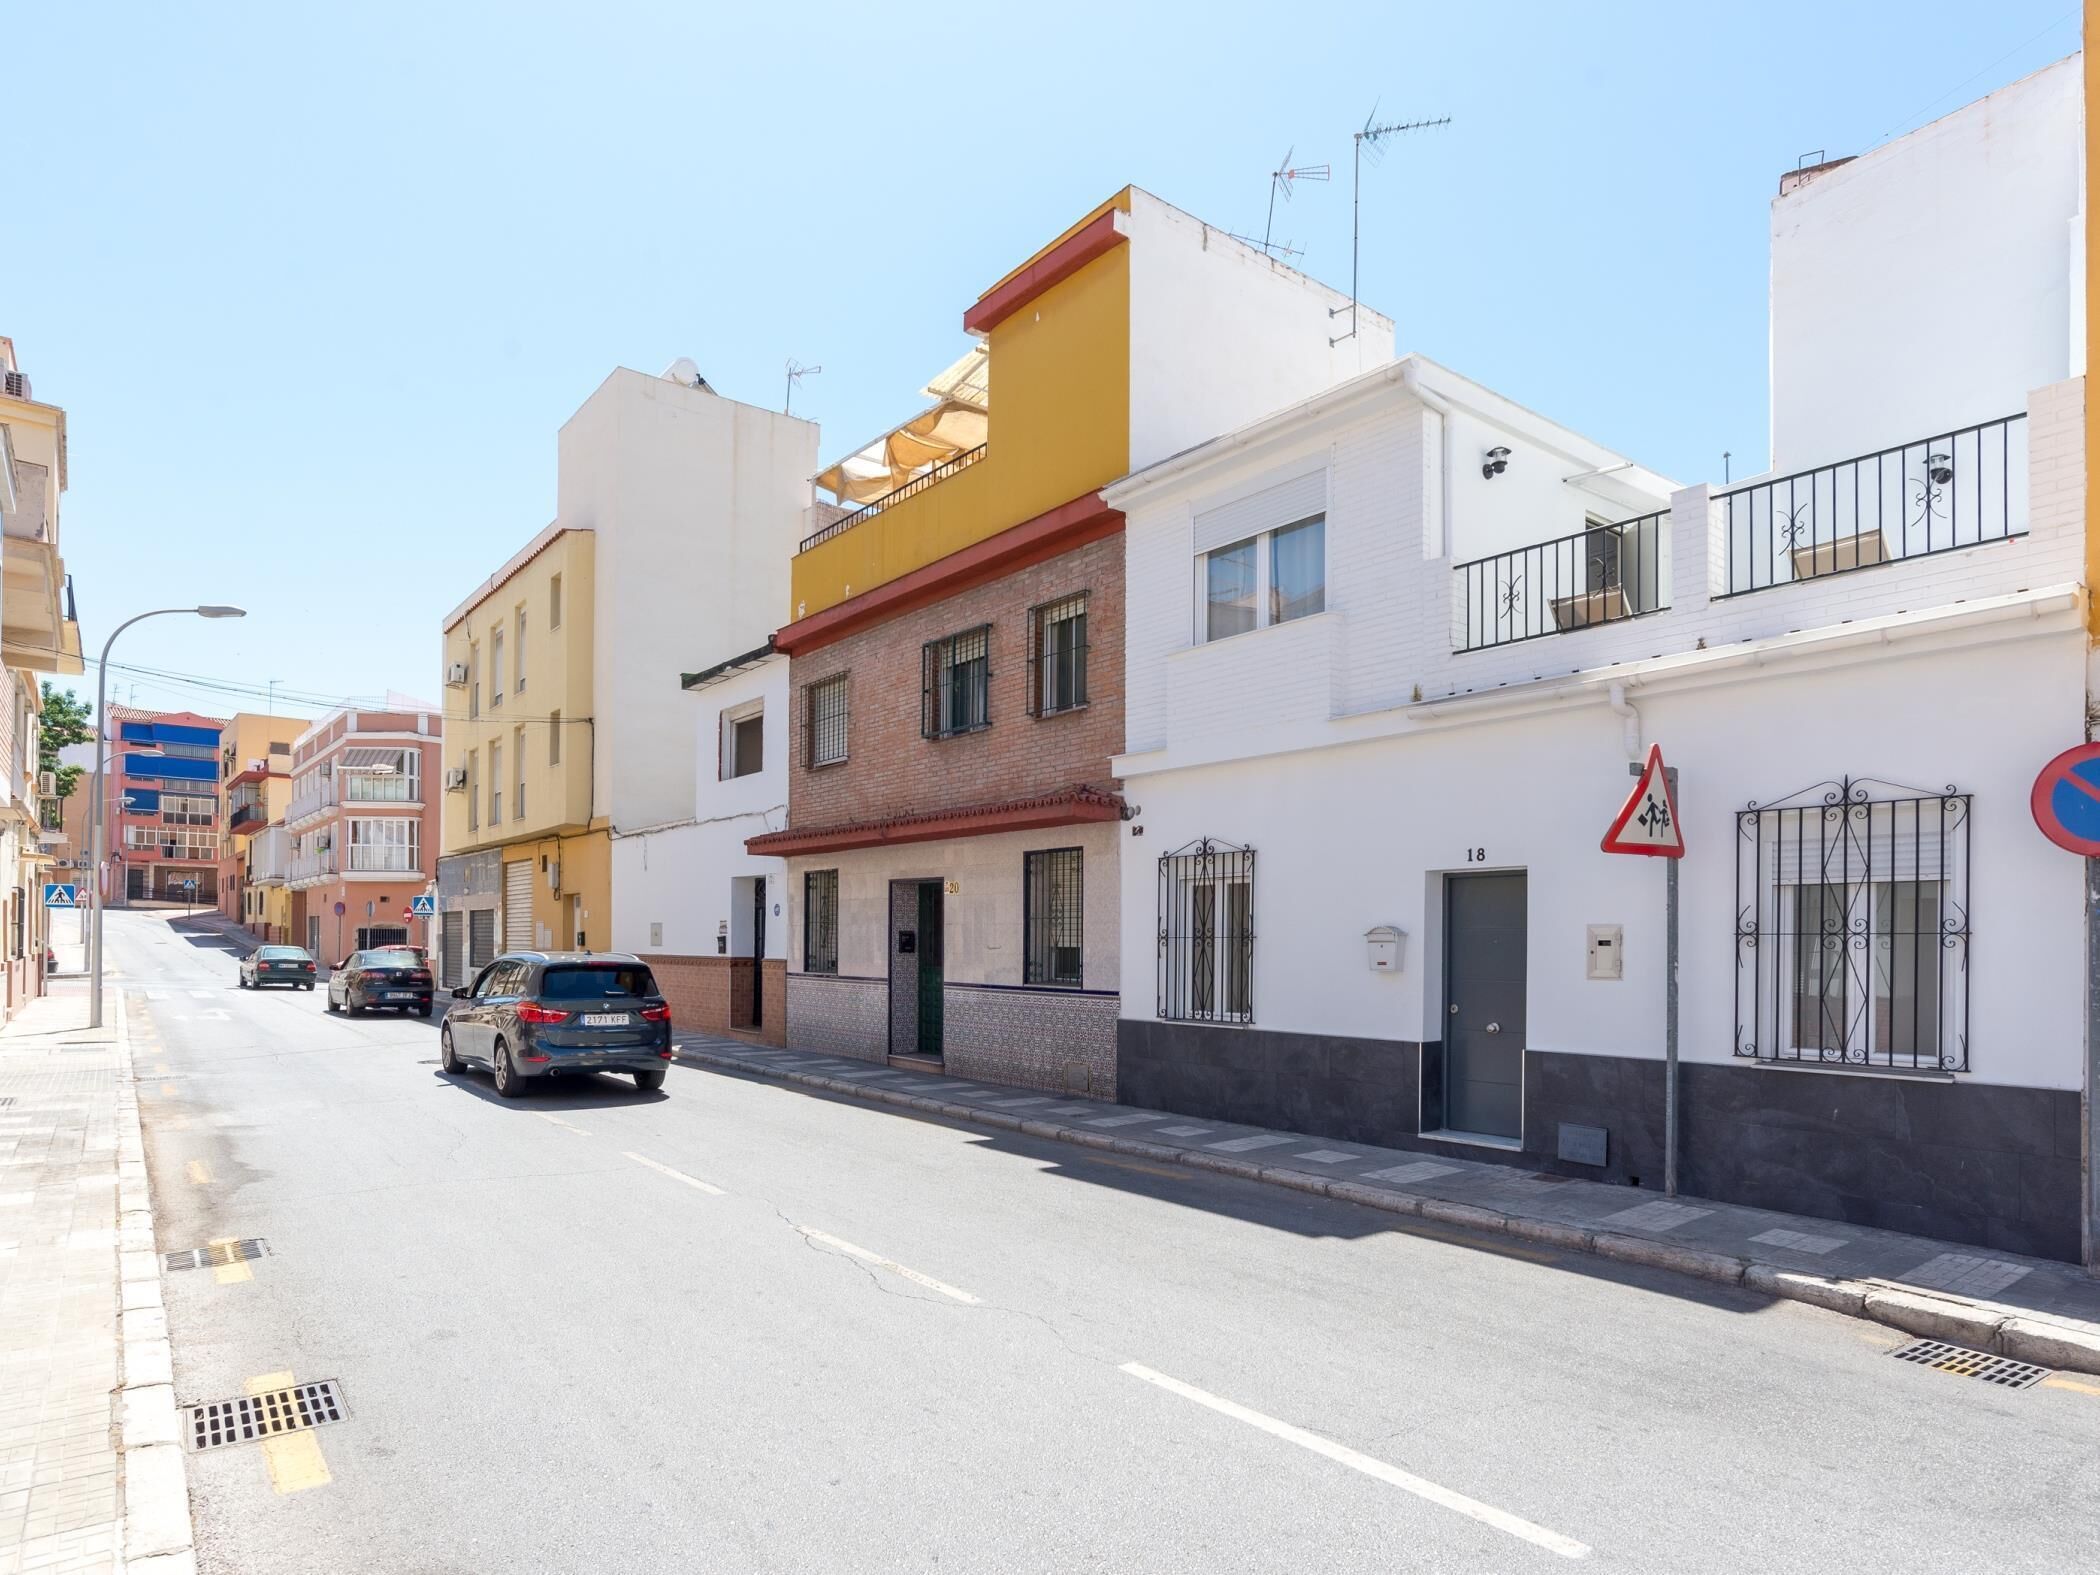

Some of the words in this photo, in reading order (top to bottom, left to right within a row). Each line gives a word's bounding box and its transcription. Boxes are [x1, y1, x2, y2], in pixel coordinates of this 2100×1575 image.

[1467, 848, 1486, 862] 18
[949, 882, 960, 894] 20
[586, 1015, 608, 1025] 2171
[611, 1015, 628, 1024] KFF
